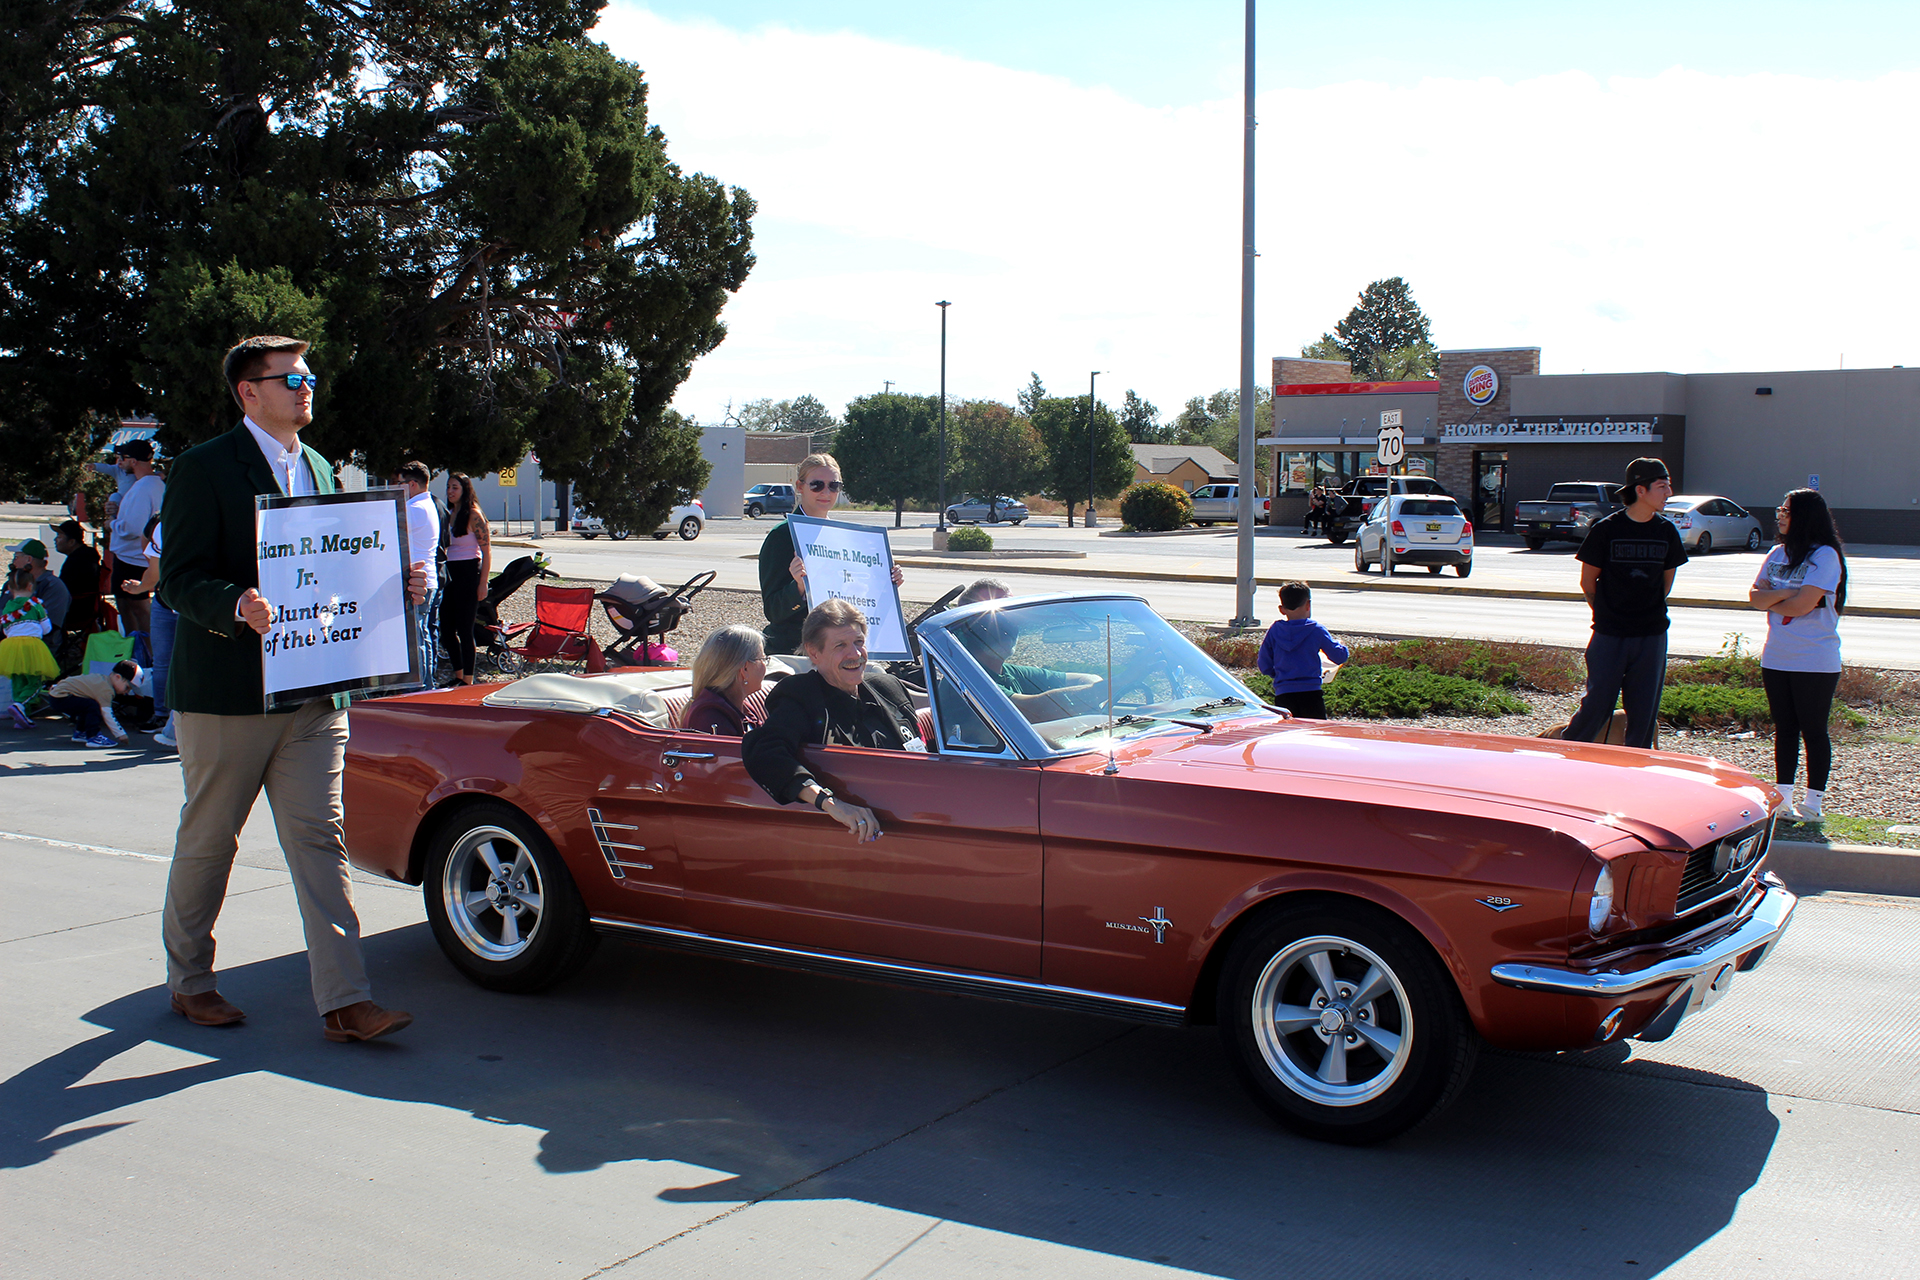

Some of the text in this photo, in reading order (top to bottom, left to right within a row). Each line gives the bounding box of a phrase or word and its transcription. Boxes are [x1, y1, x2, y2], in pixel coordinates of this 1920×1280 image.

[1469, 373, 1492, 387] BURGER
[1470, 379, 1493, 396] KING
[1383, 413, 1398, 424] EAST
[1444, 422, 1651, 436] HOME OF THE WHOPPER
[1381, 436, 1400, 457] 70
[500, 468, 515, 479] 20
[258, 530, 386, 560] liam R. Magel,
[805, 543, 883, 568] William R. Magel,
[295, 567, 318, 589] Jr.
[843, 569, 854, 583] Jr.
[863, 614, 881, 626] ear
[265, 625, 362, 657] of the Year
[1486, 895, 1511, 905] 289
[1105, 921, 1150, 934] MUSTANG
